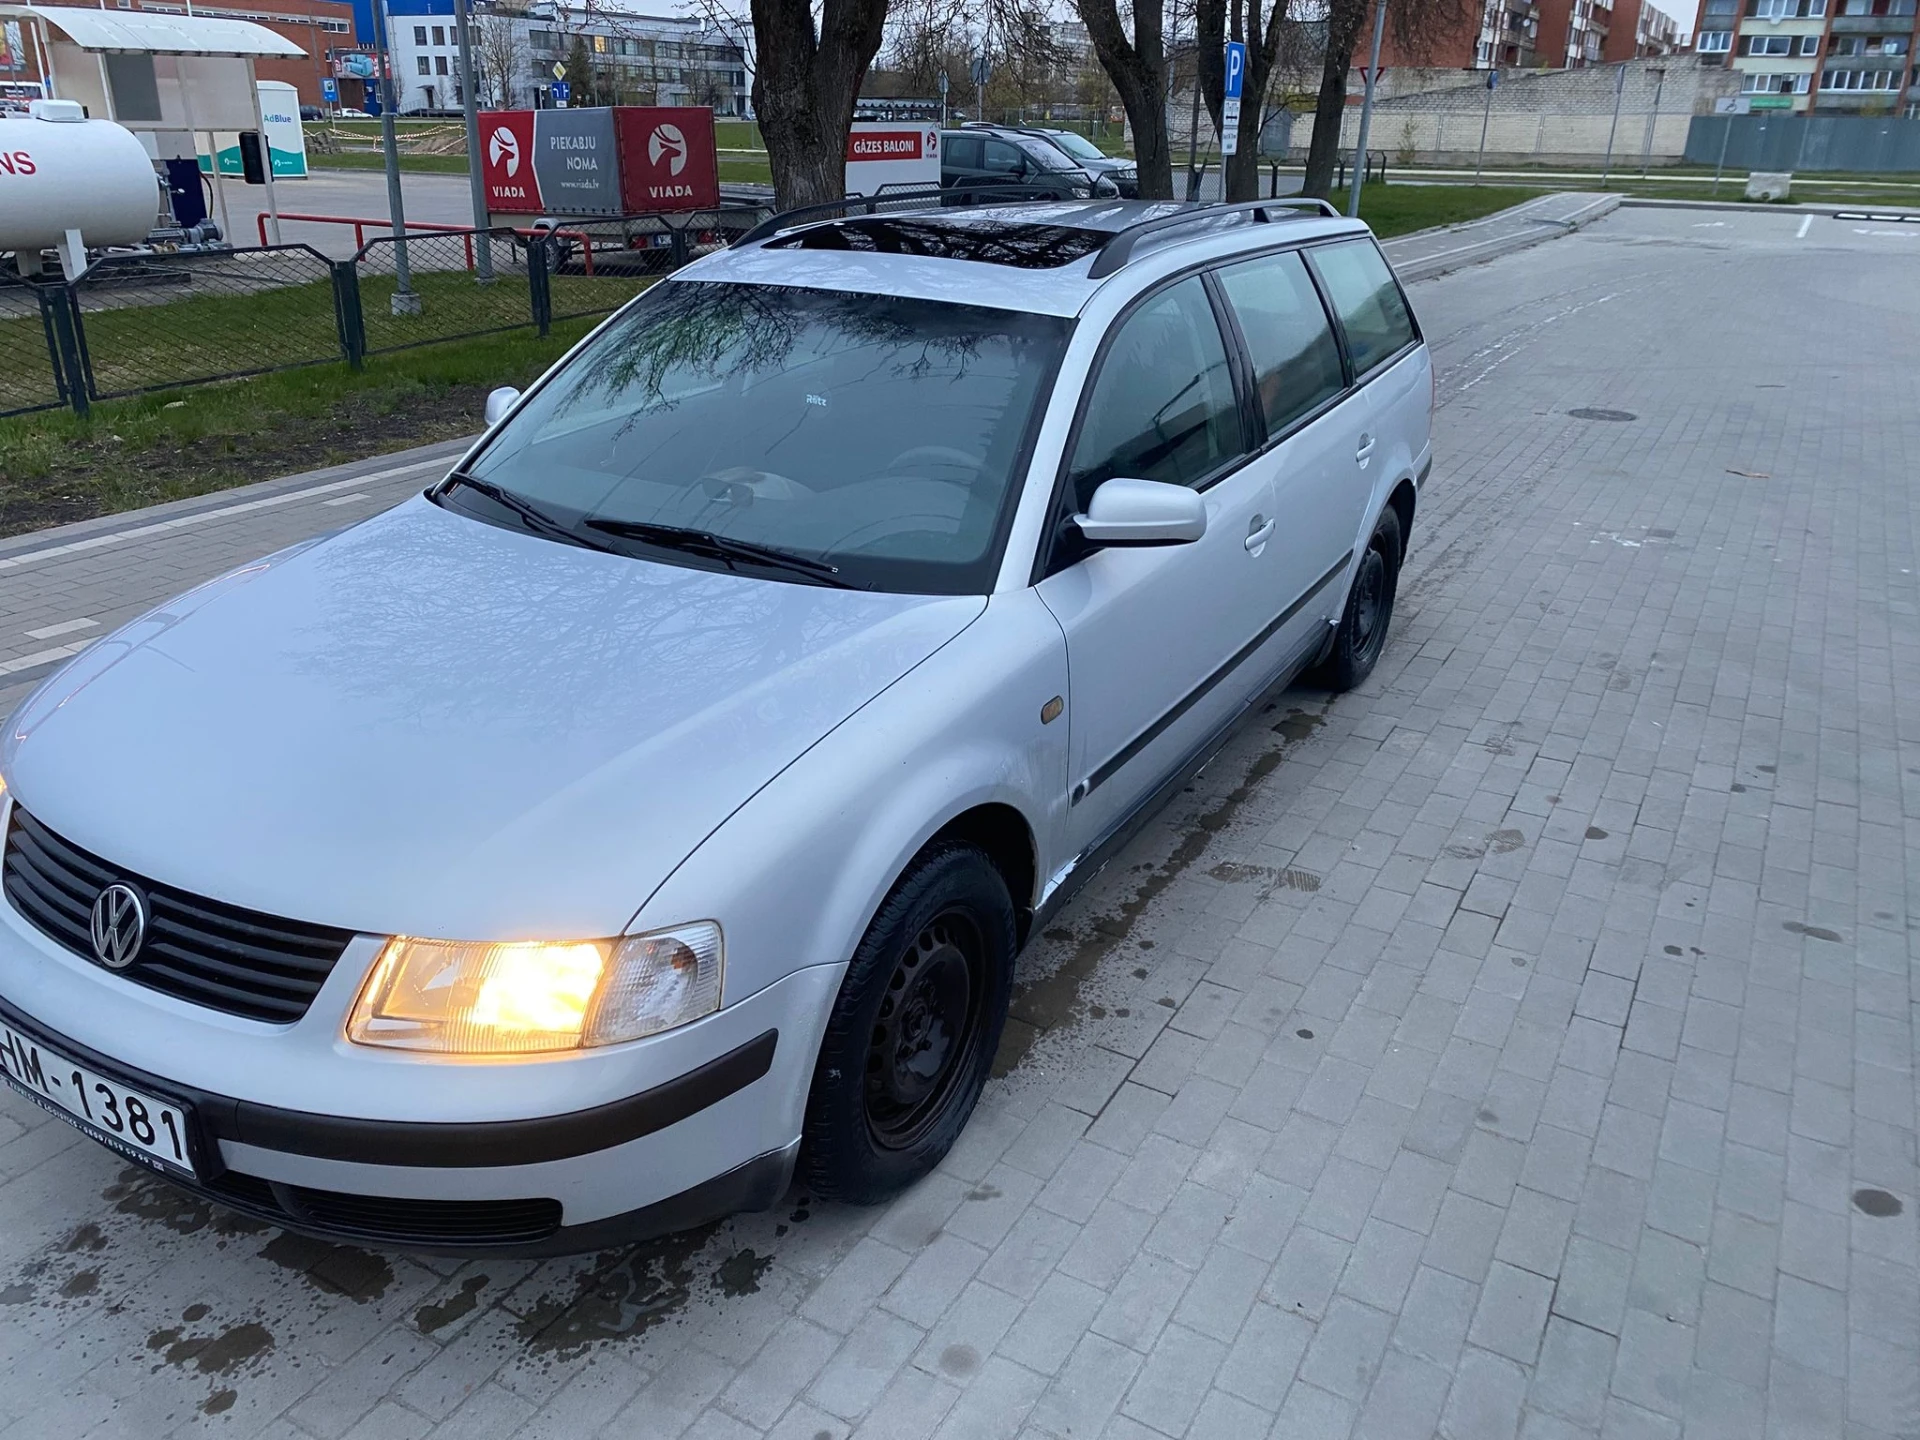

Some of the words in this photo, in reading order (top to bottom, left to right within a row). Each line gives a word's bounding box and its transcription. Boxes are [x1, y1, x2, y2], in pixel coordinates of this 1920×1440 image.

[1229, 50, 1241, 91] P
[263, 114, 292, 123] AdBlue
[550, 136, 596, 150] PIEKABJU
[853, 138, 882, 154] GĀZES
[883, 139, 915, 153] BALONI
[0, 151, 36, 175] NS
[566, 156, 598, 170] NOMA
[492, 185, 526, 198] VIADA
[648, 184, 693, 198] VIADA
[91, 884, 145, 968] VW
[0, 1029, 183, 1161] HM-1381
